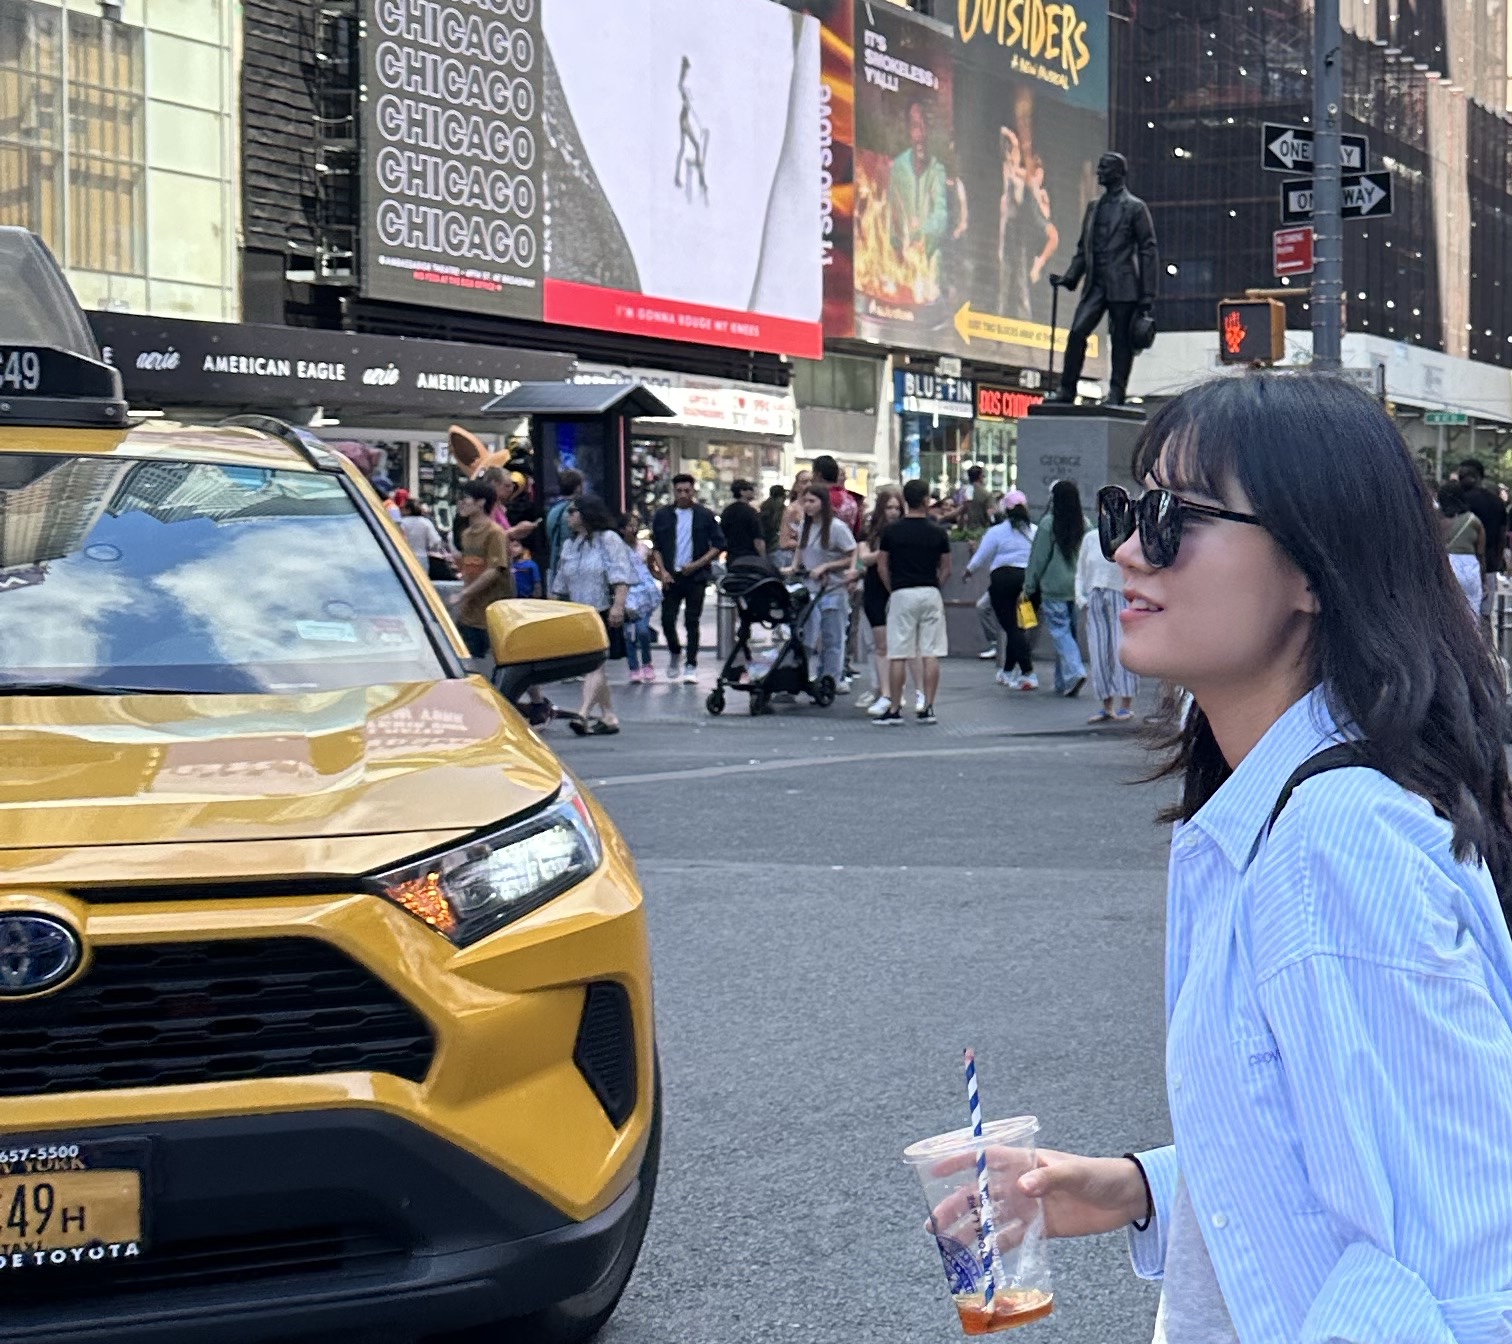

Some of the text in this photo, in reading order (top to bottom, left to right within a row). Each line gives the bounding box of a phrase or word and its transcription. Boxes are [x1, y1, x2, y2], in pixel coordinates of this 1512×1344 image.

[374, 41, 535, 122] CHICAGO
[375, 94, 535, 170] CHICAGO
[1279, 140, 1310, 160] ONE
[375, 146, 536, 220] CHICAGO
[1342, 186, 1376, 206] WAY
[376, 199, 536, 268] CHICAGO
[0, 350, 41, 391] 49
[203, 355, 291, 378] AMERICAN
[297, 359, 346, 382] EAGLE
[416, 372, 490, 395] AMERICAN
[904, 371, 973, 402] BLUE FIN
[0, 1182, 87, 1237] 49H
[33, 1242, 140, 1266] TOYOTA
